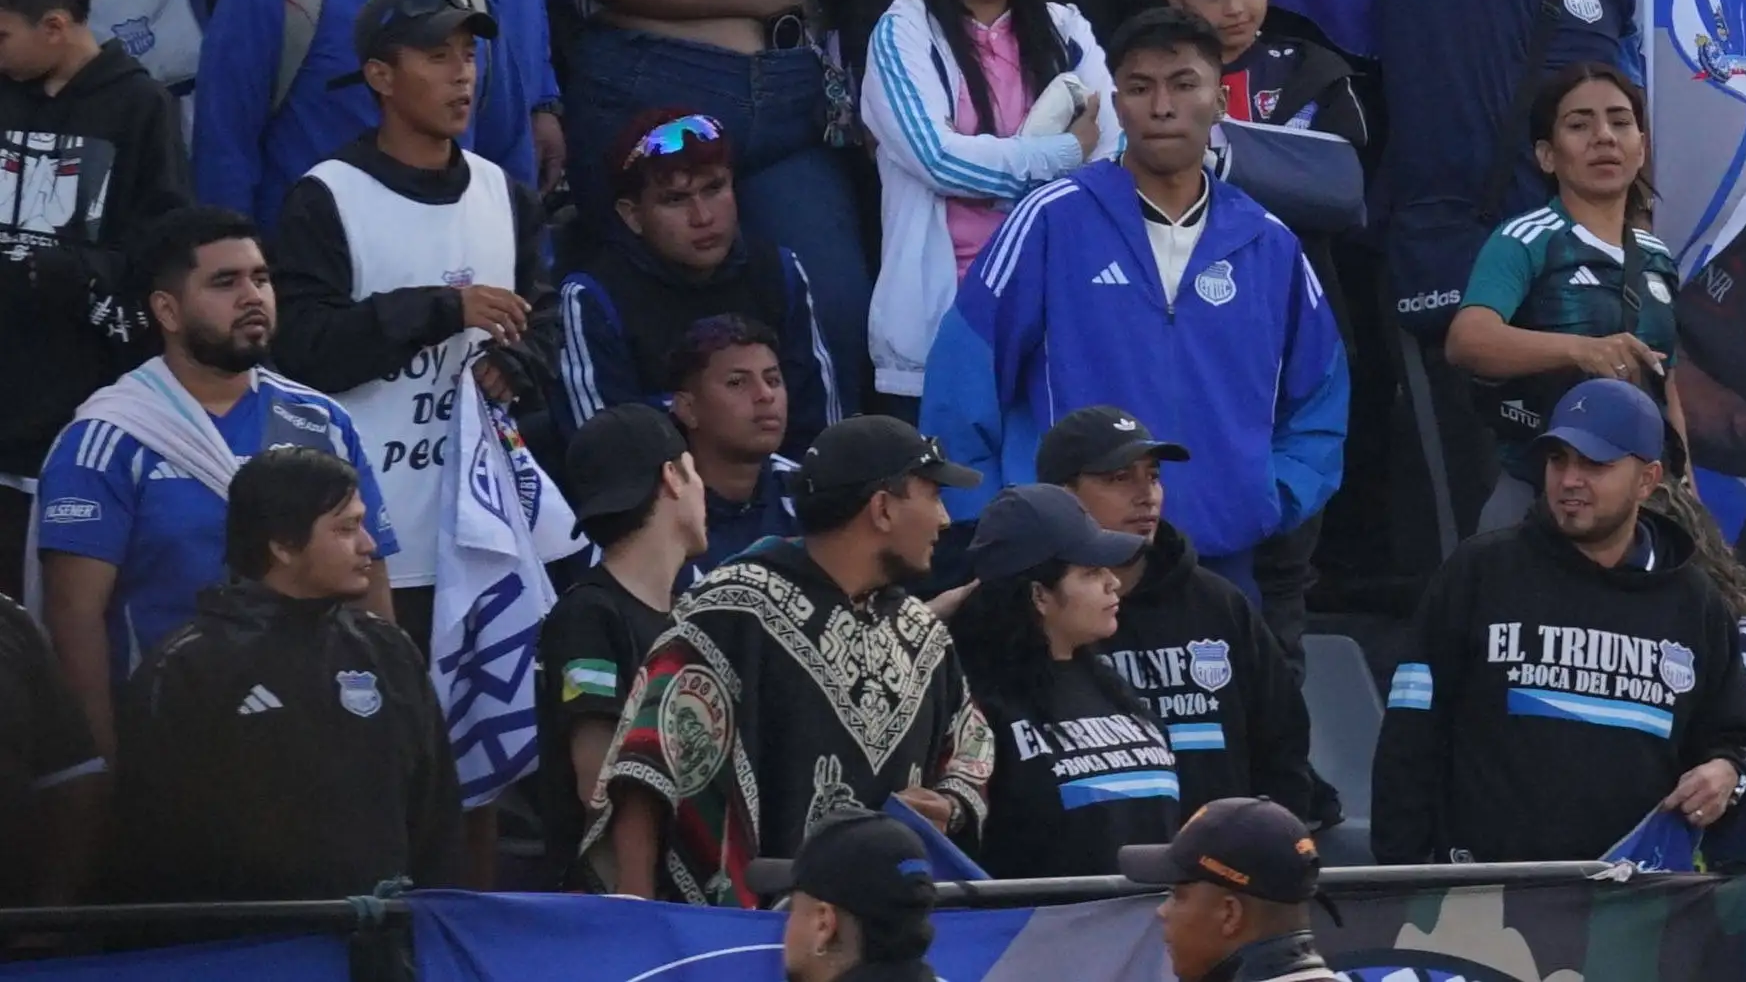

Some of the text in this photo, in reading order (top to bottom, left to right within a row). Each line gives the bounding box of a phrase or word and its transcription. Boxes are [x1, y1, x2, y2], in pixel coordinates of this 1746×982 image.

[1397, 288, 1461, 313] adidas
[412, 388, 453, 425] DE
[1487, 621, 1527, 666] EL
[1519, 663, 1571, 691] BOCA
[1573, 670, 1610, 695] DEL
[1612, 675, 1665, 705] POZO
[1159, 691, 1209, 719] POZO
[1063, 750, 1107, 779] BOCA
[1106, 748, 1138, 771] DEL
